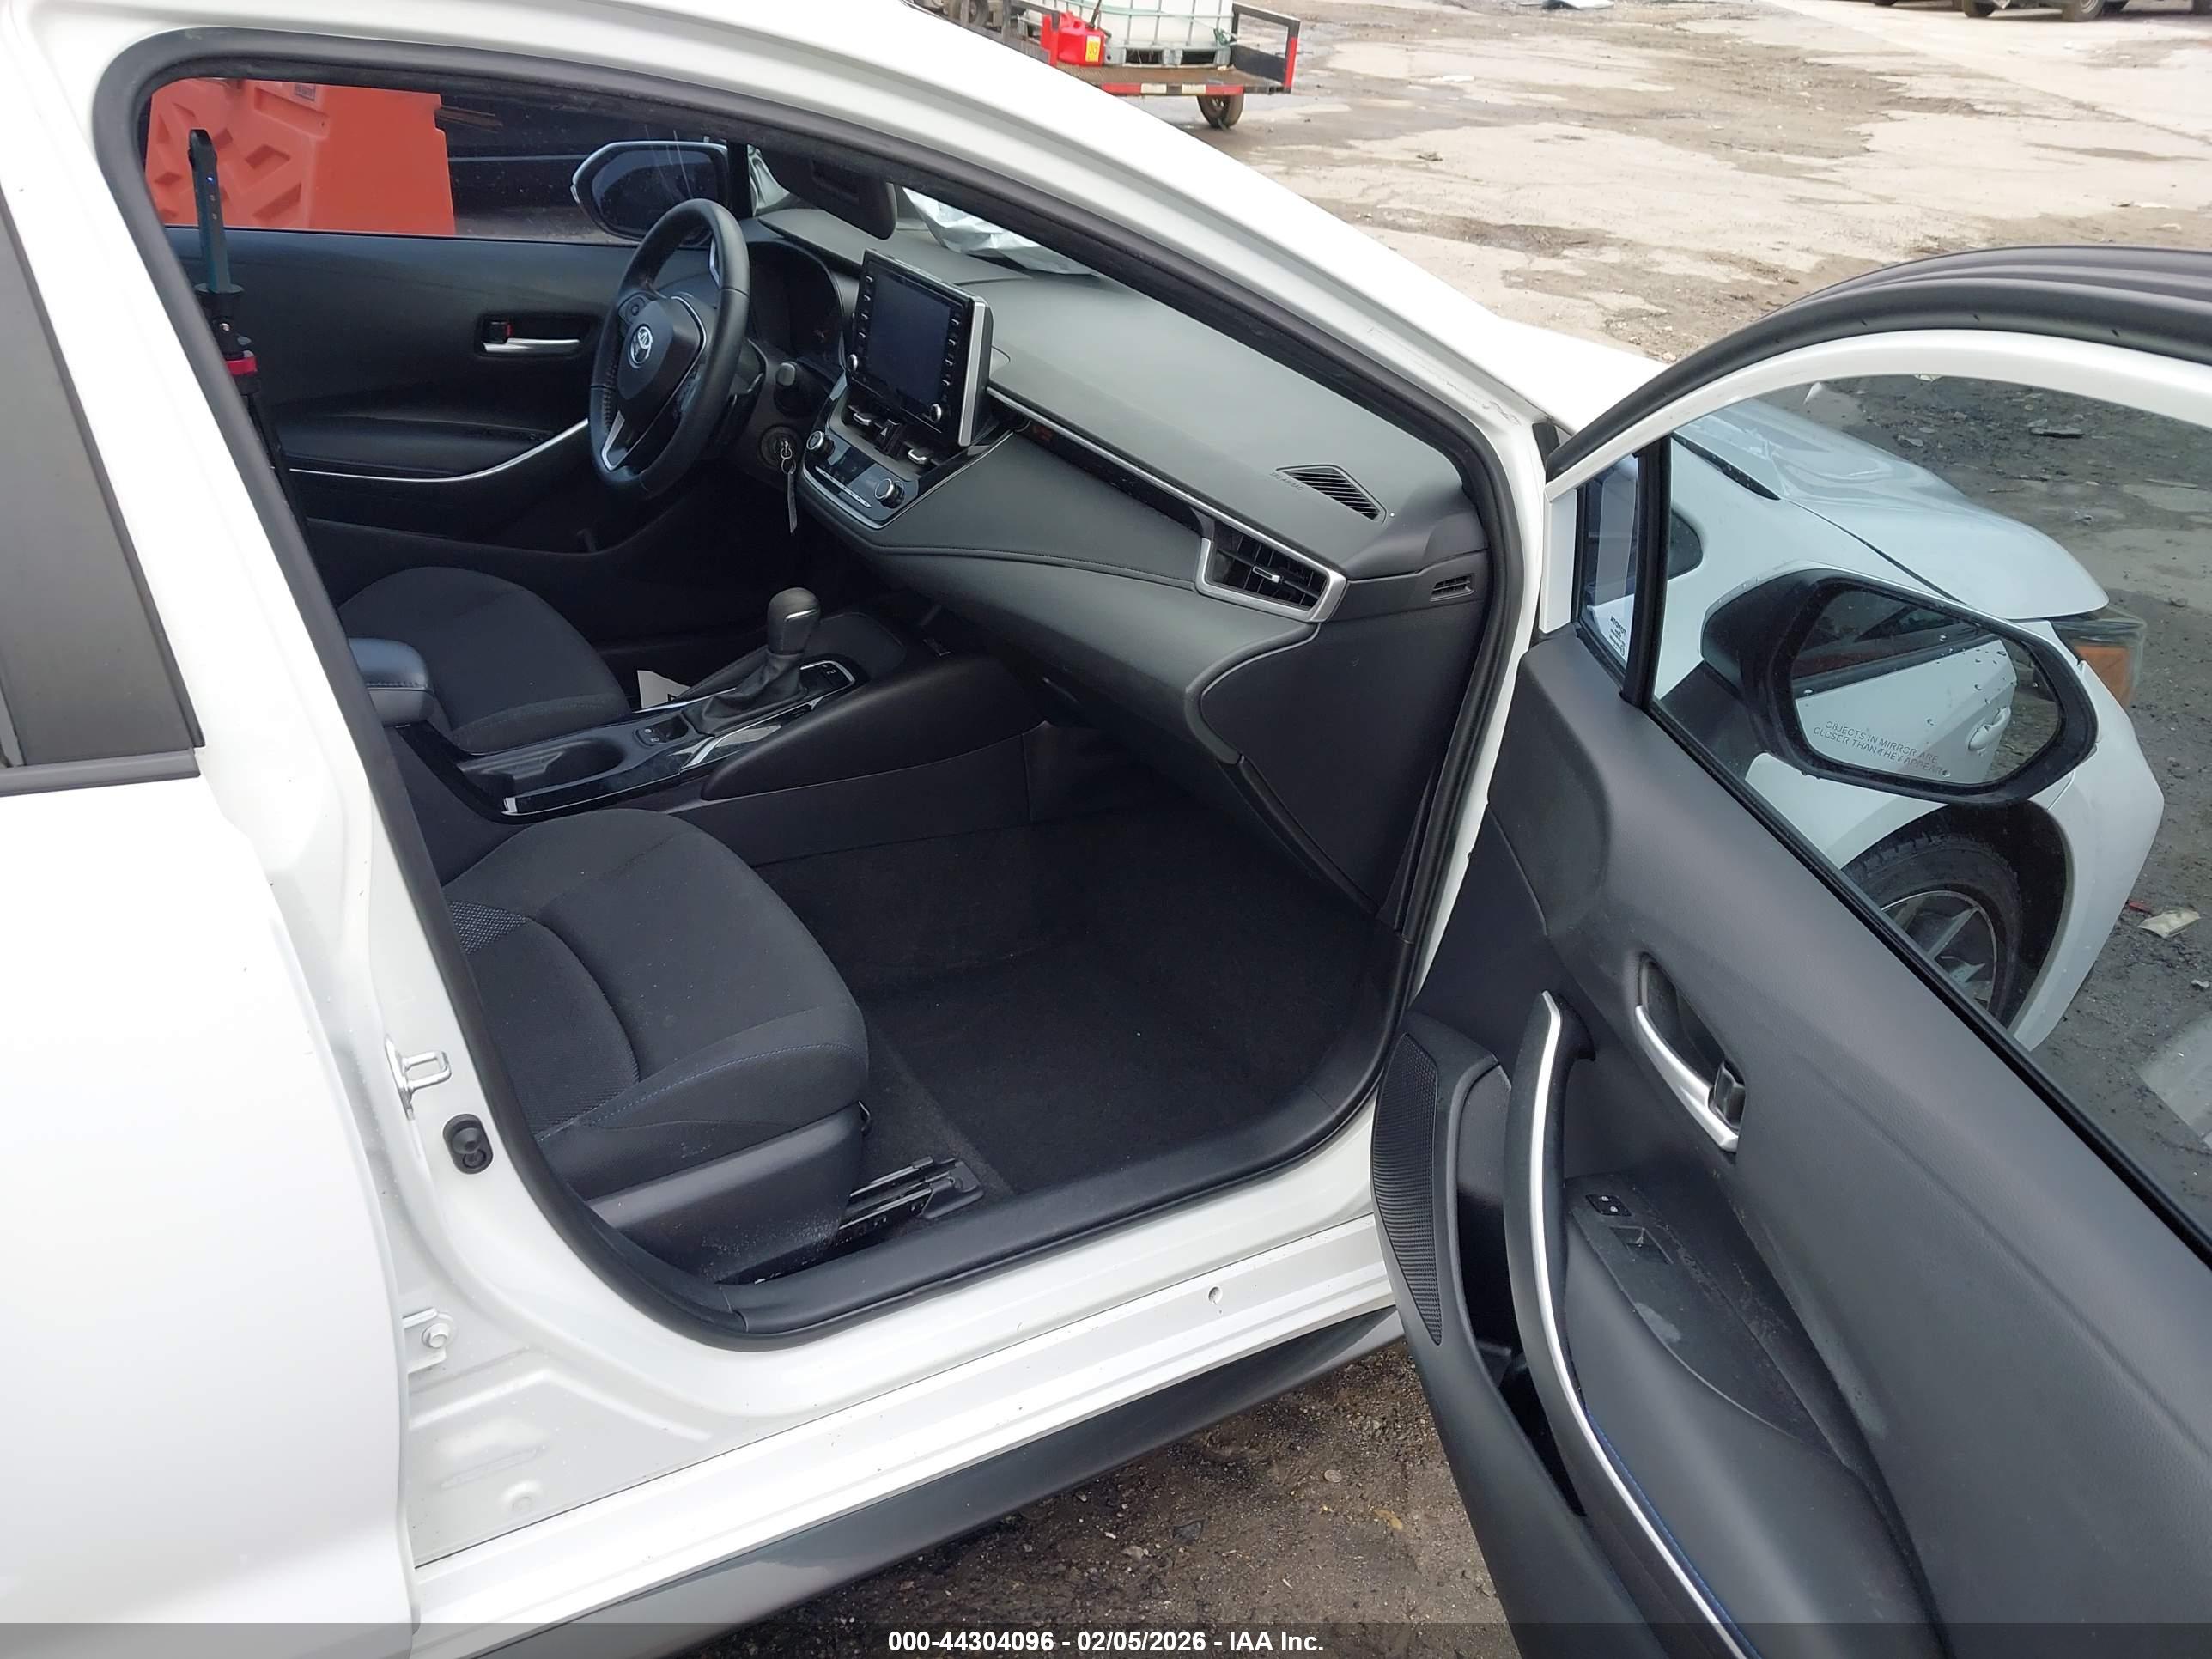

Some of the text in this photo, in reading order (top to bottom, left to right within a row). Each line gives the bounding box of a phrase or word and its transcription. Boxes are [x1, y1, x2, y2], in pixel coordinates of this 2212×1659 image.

[1814, 726, 1850, 745] CLOSER
[1852, 738, 1877, 754] THAN
[1877, 748, 1904, 762] THEY
[1826, 720, 1938, 763] OBJECTS IN MIRROR ARE
